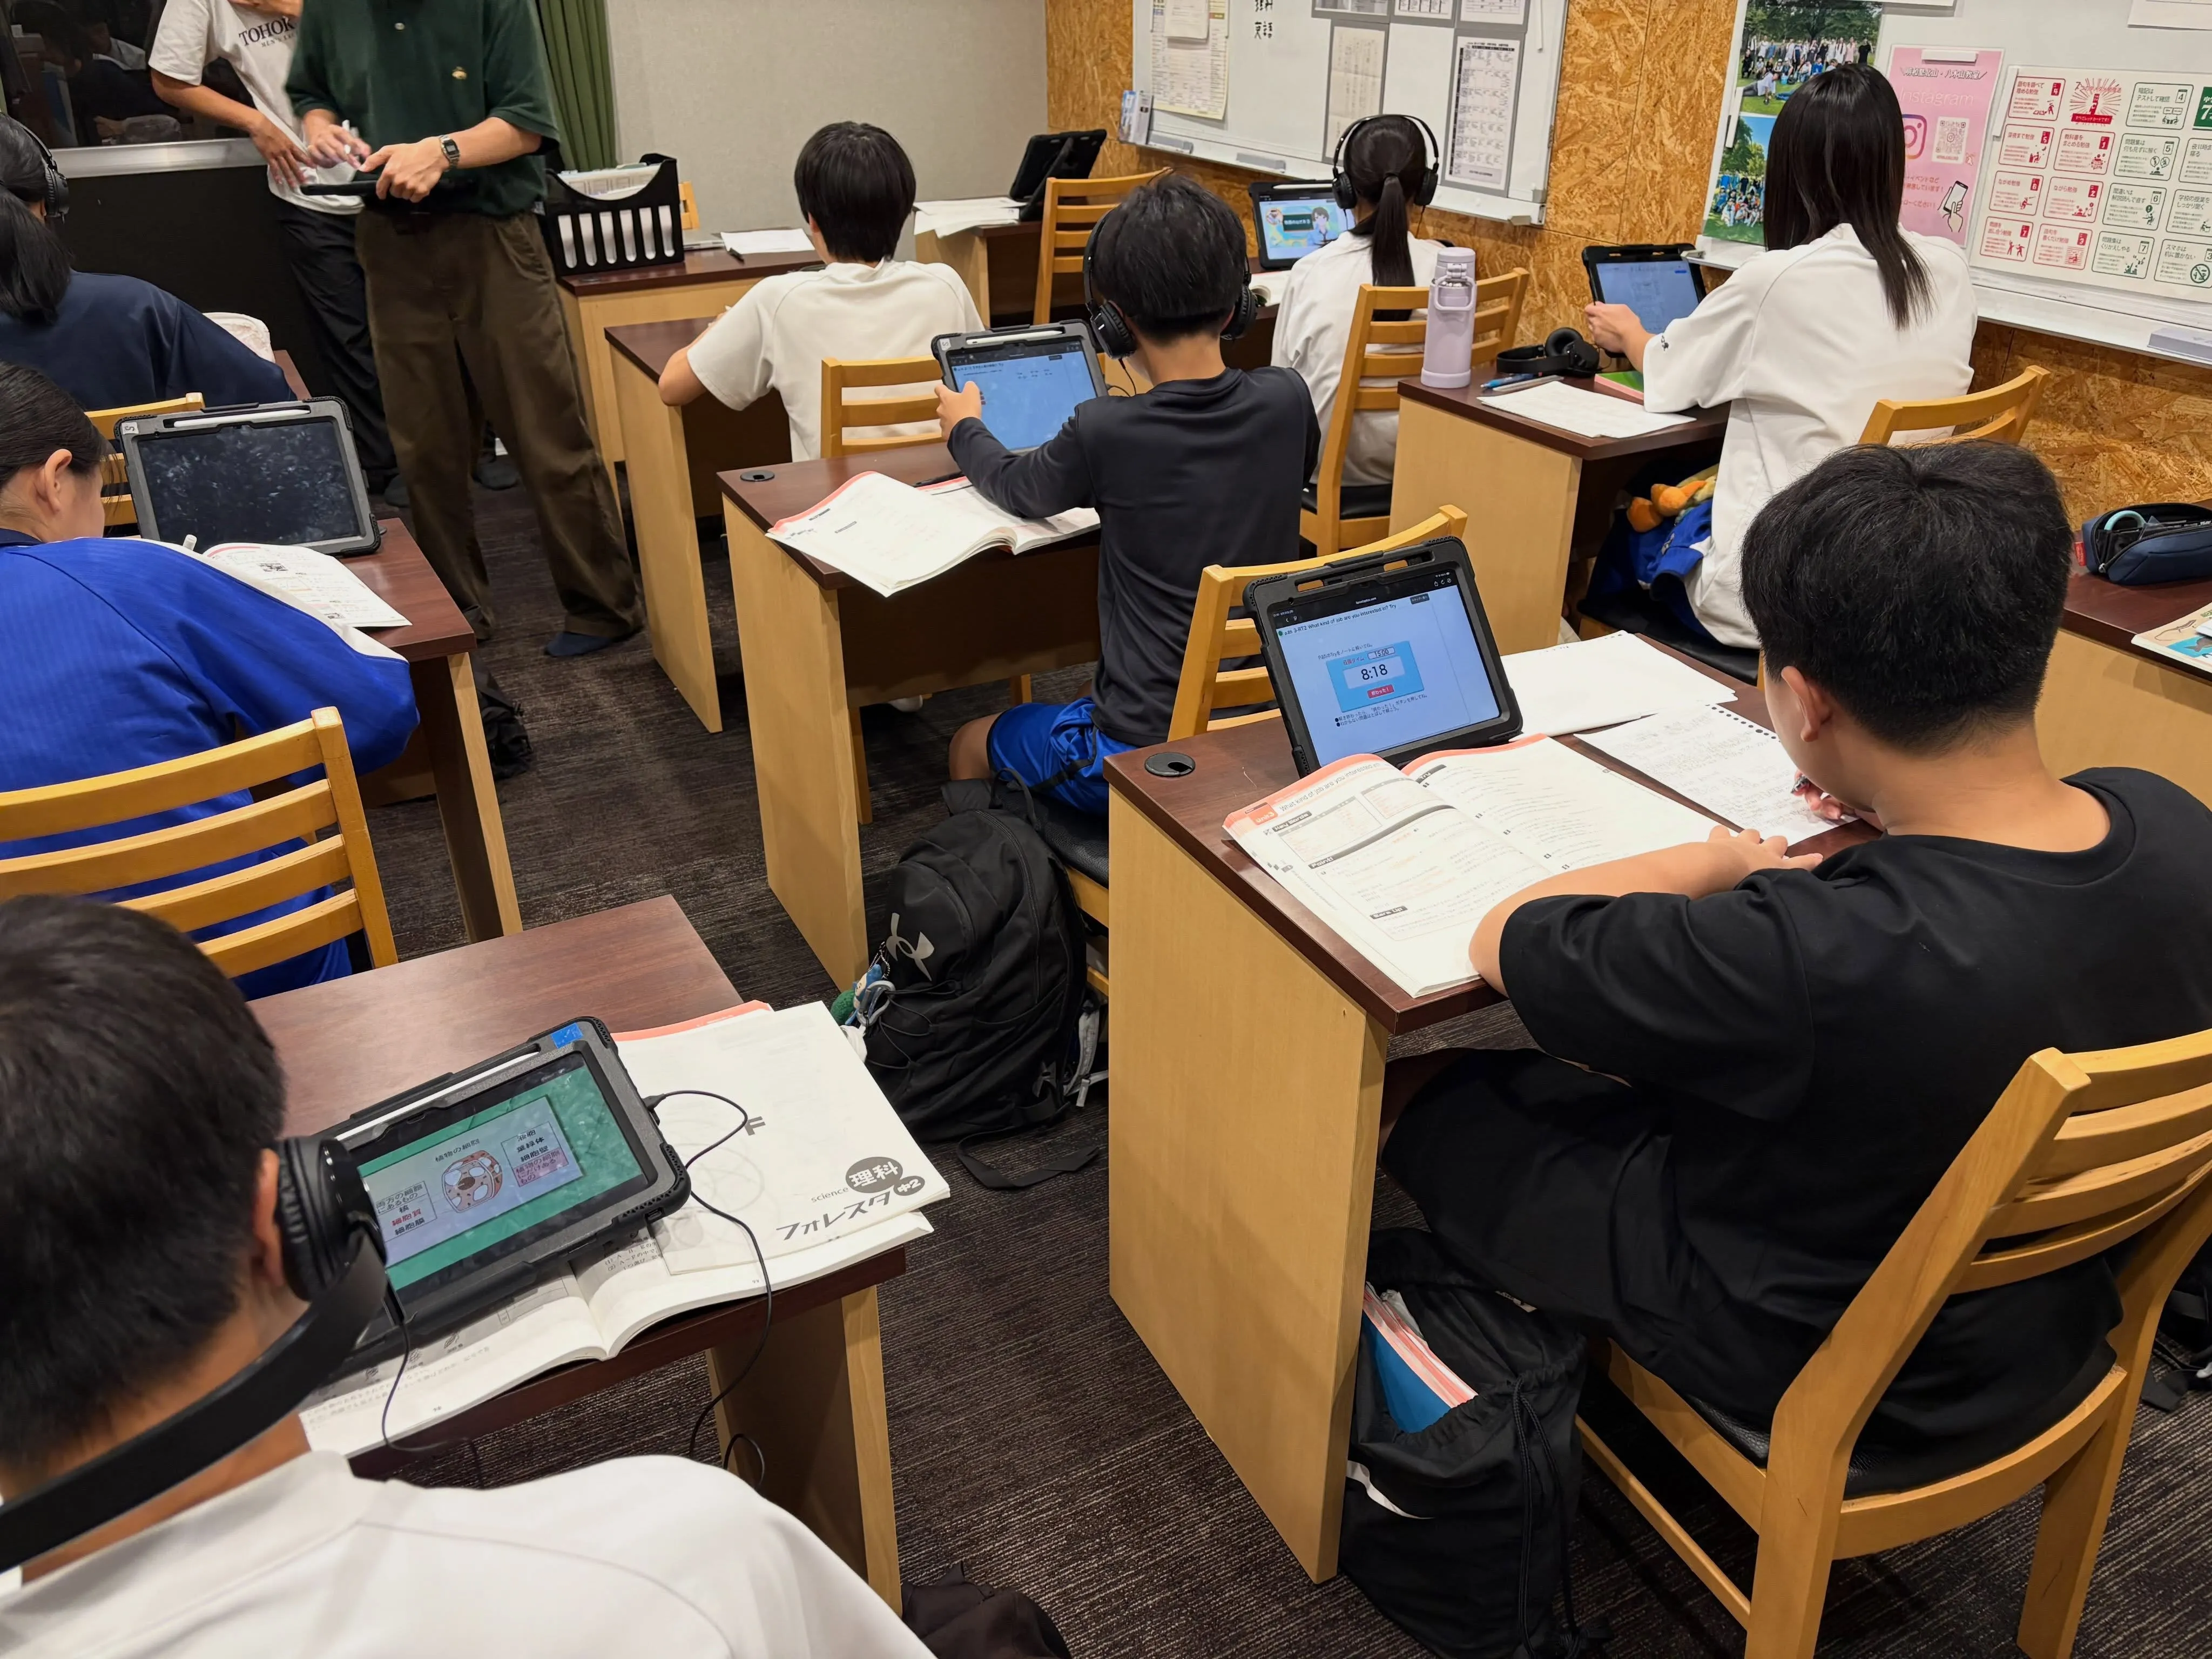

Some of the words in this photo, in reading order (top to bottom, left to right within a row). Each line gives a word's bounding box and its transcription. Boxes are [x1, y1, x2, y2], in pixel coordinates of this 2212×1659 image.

[1255, 22, 1273, 39] 英語
[1899, 87, 1974, 106] Instagram
[2112, 195, 2146, 203] 解説読んで直す
[2113, 187, 2134, 195] 間違いは
[2179, 194, 2210, 203] 学校の授業を
[2101, 243, 2130, 252] くりかえしやる
[2164, 251, 2196, 259] 机に置かない
[1360, 608, 1382, 617] interested
[1360, 664, 1388, 680] 8:18
[1279, 801, 1296, 812] What
[1296, 795, 1308, 805] kind
[1308, 790, 1314, 798] of
[1314, 786, 1325, 797] job
[1325, 781, 1334, 790] are
[1334, 775, 1345, 785] you
[1345, 764, 1373, 778] interested
[1274, 822, 1289, 831] Key
[435, 1138, 480, 1162] 植物の細胞
[516, 1137, 545, 1153] 葉緑体
[521, 1145, 549, 1162] 細胞壁
[516, 1150, 561, 1174] 植物の細胞
[518, 1158, 556, 1178] にだけある
[521, 1173, 536, 1184] もの
[848, 1161, 899, 1187] 理科
[897, 1178, 921, 1193] 中2
[378, 1192, 418, 1213] にあるもの
[811, 1187, 849, 1203] science
[392, 1209, 421, 1226] 細胞質
[775, 1191, 891, 1240] フォレスタ
[395, 1217, 425, 1235] 細胞膜
